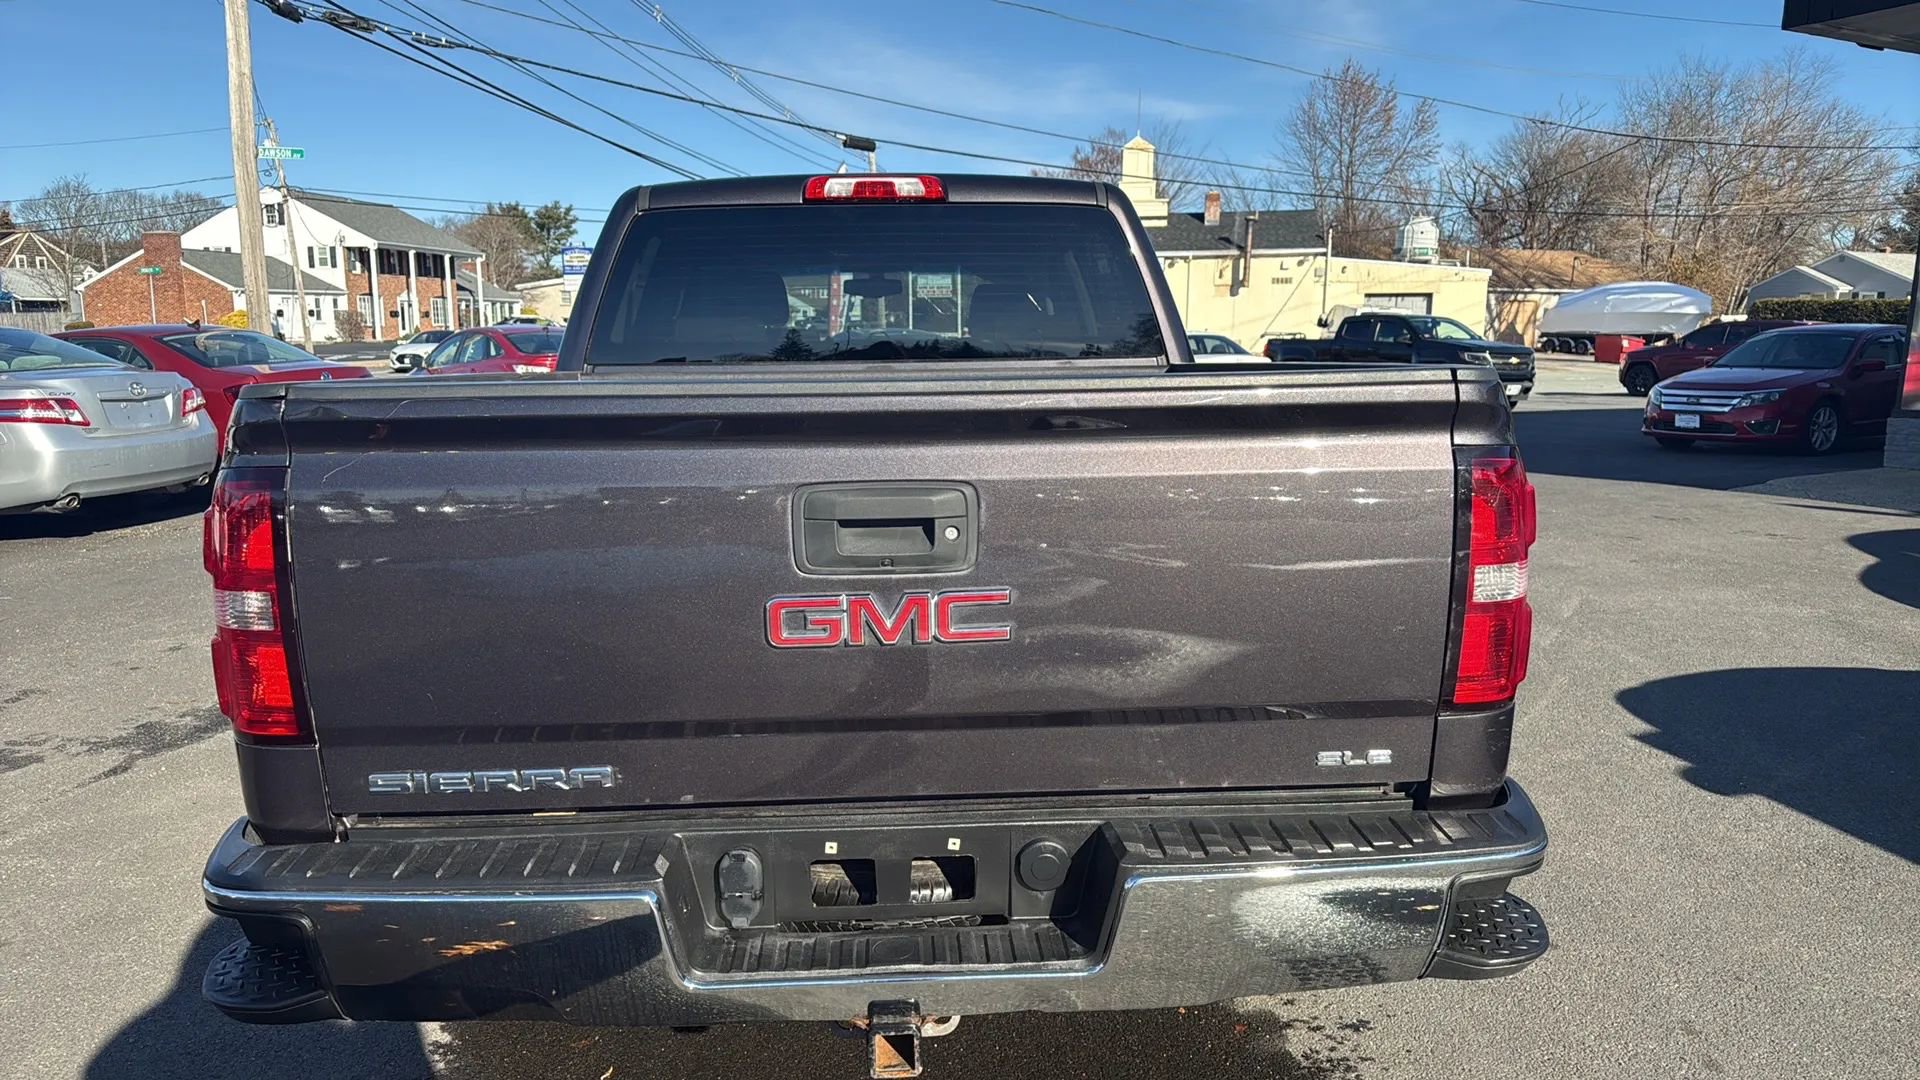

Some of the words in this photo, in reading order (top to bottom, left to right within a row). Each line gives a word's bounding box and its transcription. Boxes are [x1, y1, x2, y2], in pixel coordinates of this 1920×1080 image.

[258, 148, 292, 158] DAWSON
[766, 586, 1011, 647] GMC
[1315, 749, 1392, 767] SLE
[368, 766, 614, 794] SIERRA
